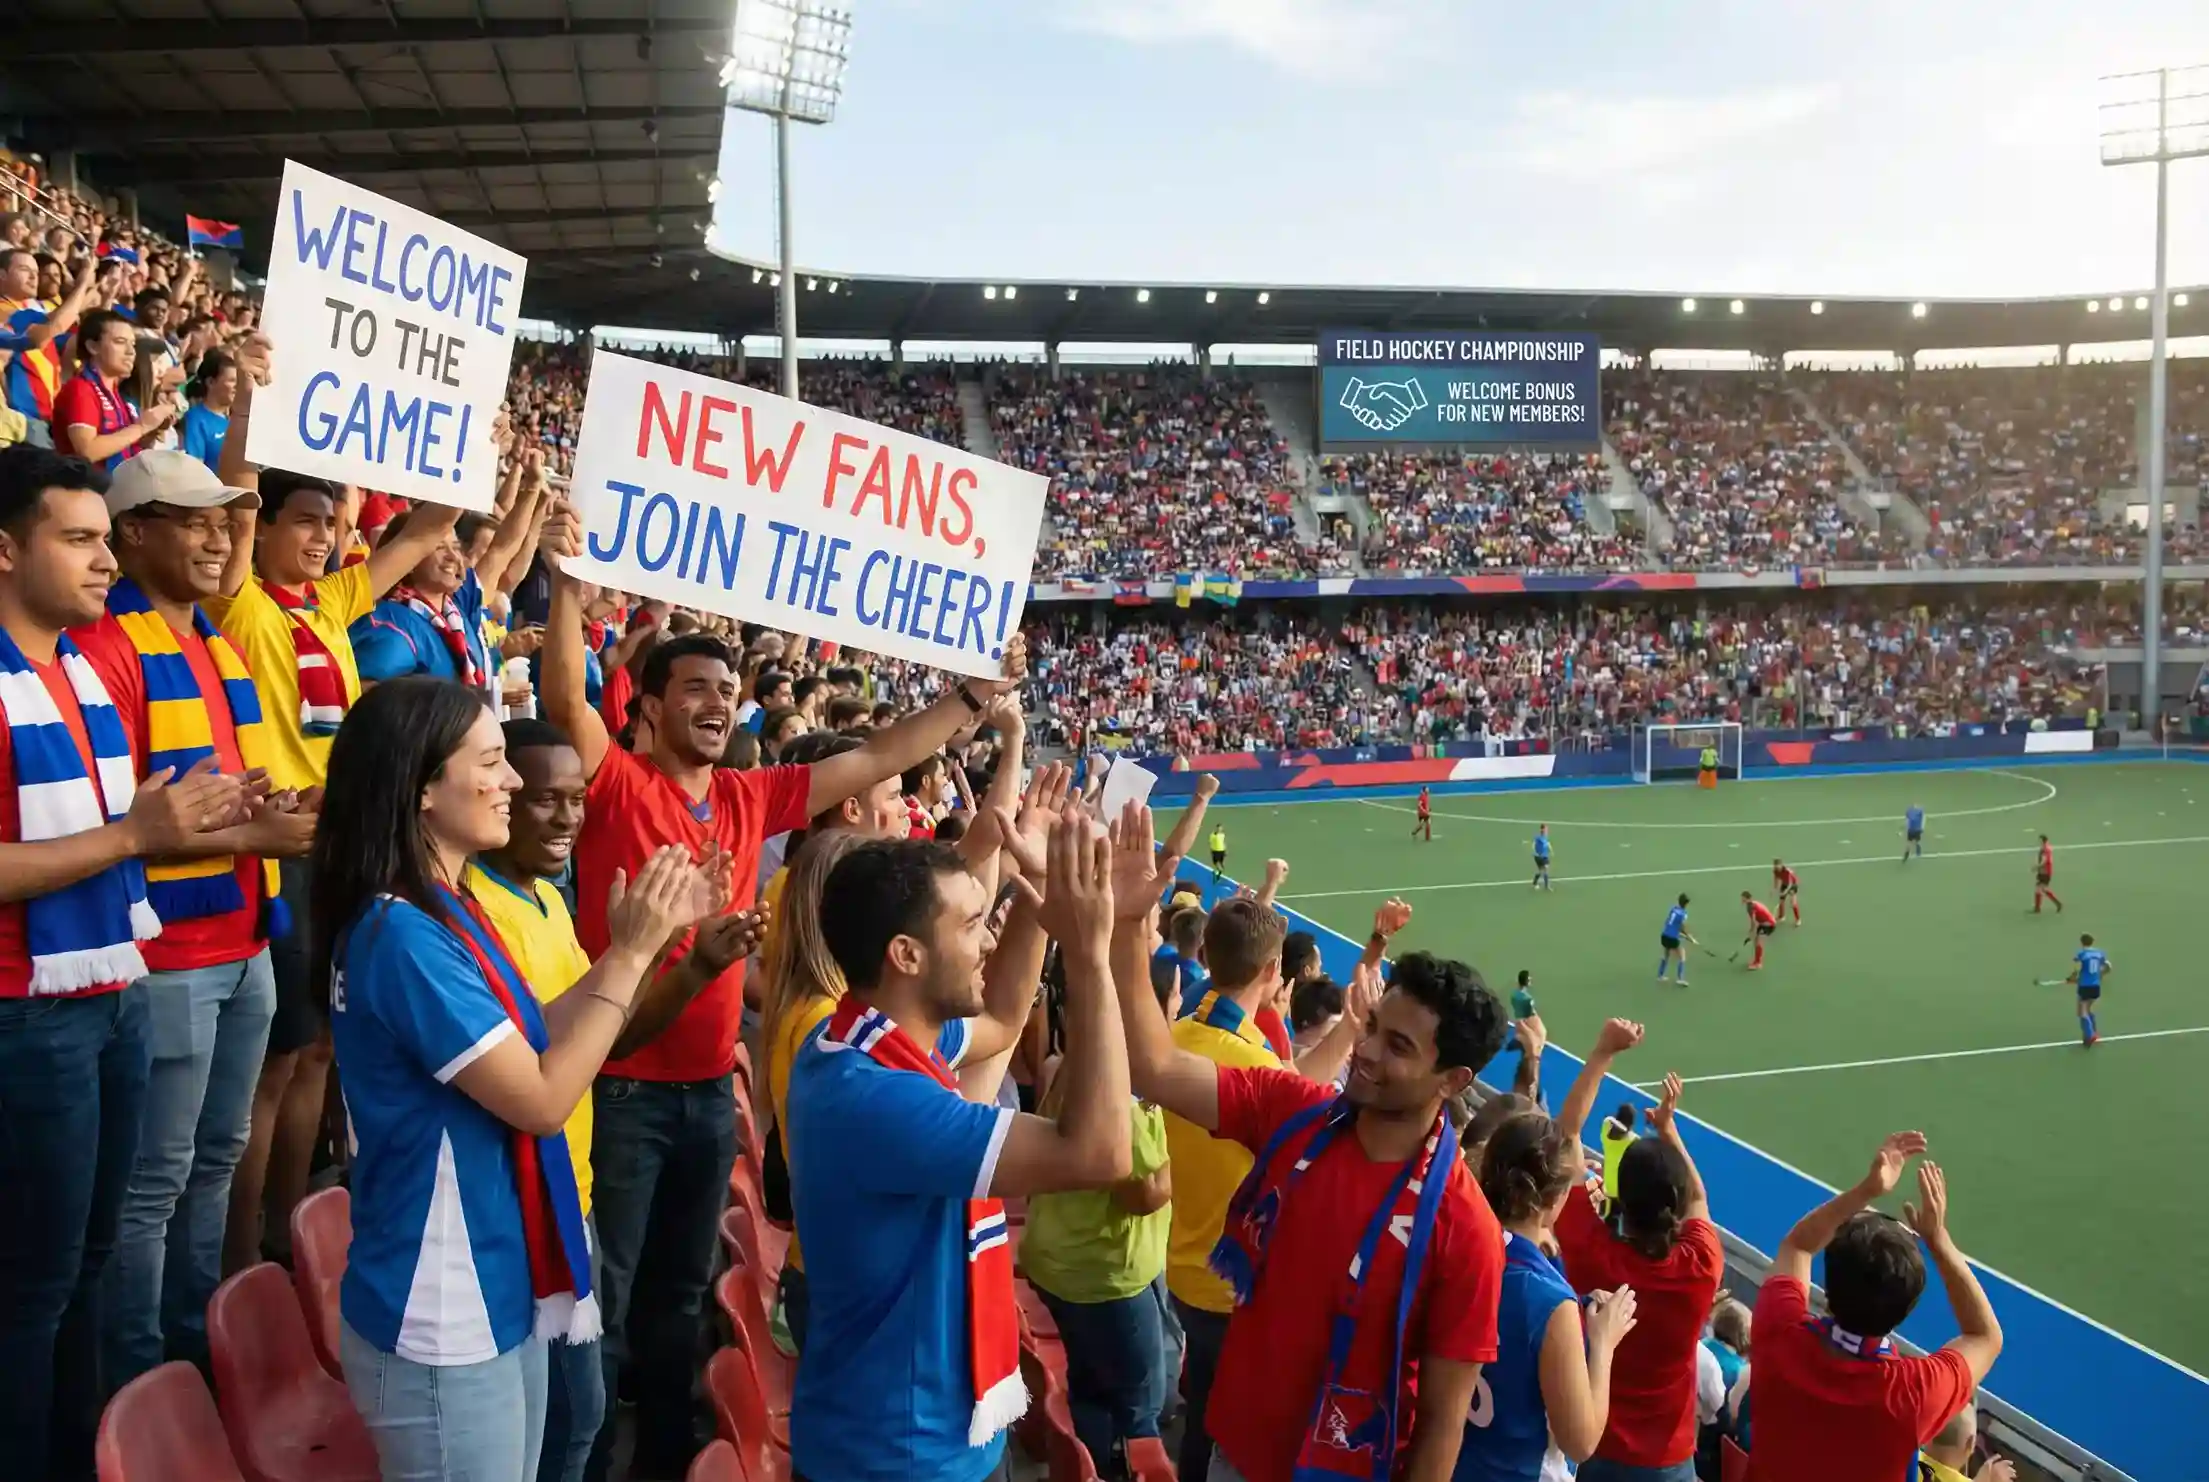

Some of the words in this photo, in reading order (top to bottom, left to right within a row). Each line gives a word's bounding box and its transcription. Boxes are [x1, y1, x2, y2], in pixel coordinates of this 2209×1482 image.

[293, 189, 513, 336] WELCOME
[325, 296, 377, 358] TO
[395, 319, 466, 388] THE
[1336, 339, 1384, 360] FIELD
[1389, 340, 1456, 360] HOCKEY
[1460, 341, 1585, 361] CHAMPIONSHIP
[1447, 382, 1521, 400] WELCOME
[1525, 382, 1576, 401] BONUS
[299, 371, 472, 483] GAME!
[1437, 404, 1467, 422] FOR
[1470, 404, 1505, 422] NEW
[1509, 404, 1585, 422] MEMBERS!
[637, 381, 806, 493] NEW
[822, 433, 987, 560] FANS,
[587, 480, 747, 591] JOIN
[766, 520, 852, 617] THE
[855, 550, 1016, 662] CHEER!
